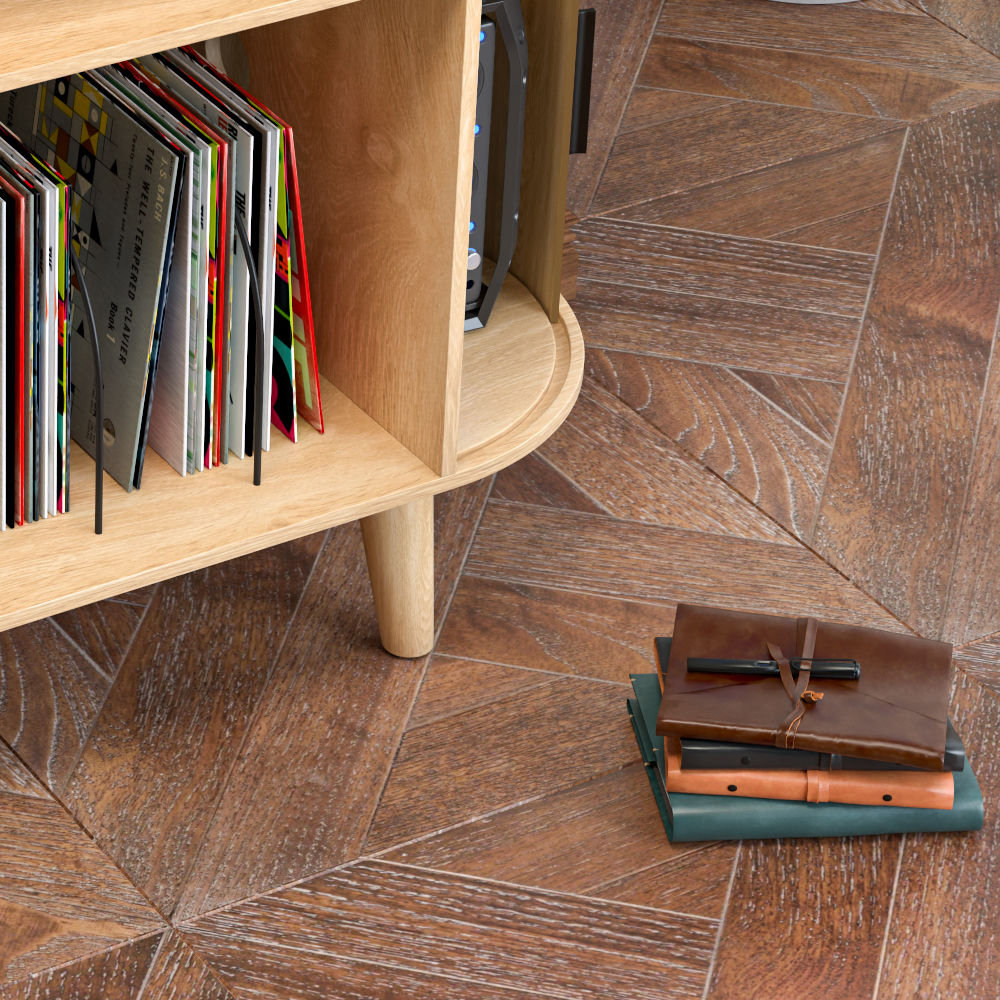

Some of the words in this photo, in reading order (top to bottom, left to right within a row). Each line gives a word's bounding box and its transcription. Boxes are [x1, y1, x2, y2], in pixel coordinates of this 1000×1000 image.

[145, 147, 155, 174] THE
[154, 183, 166, 222] BACH
[107, 302, 118, 331] Book
[118, 308, 133, 366] CLAVIER
